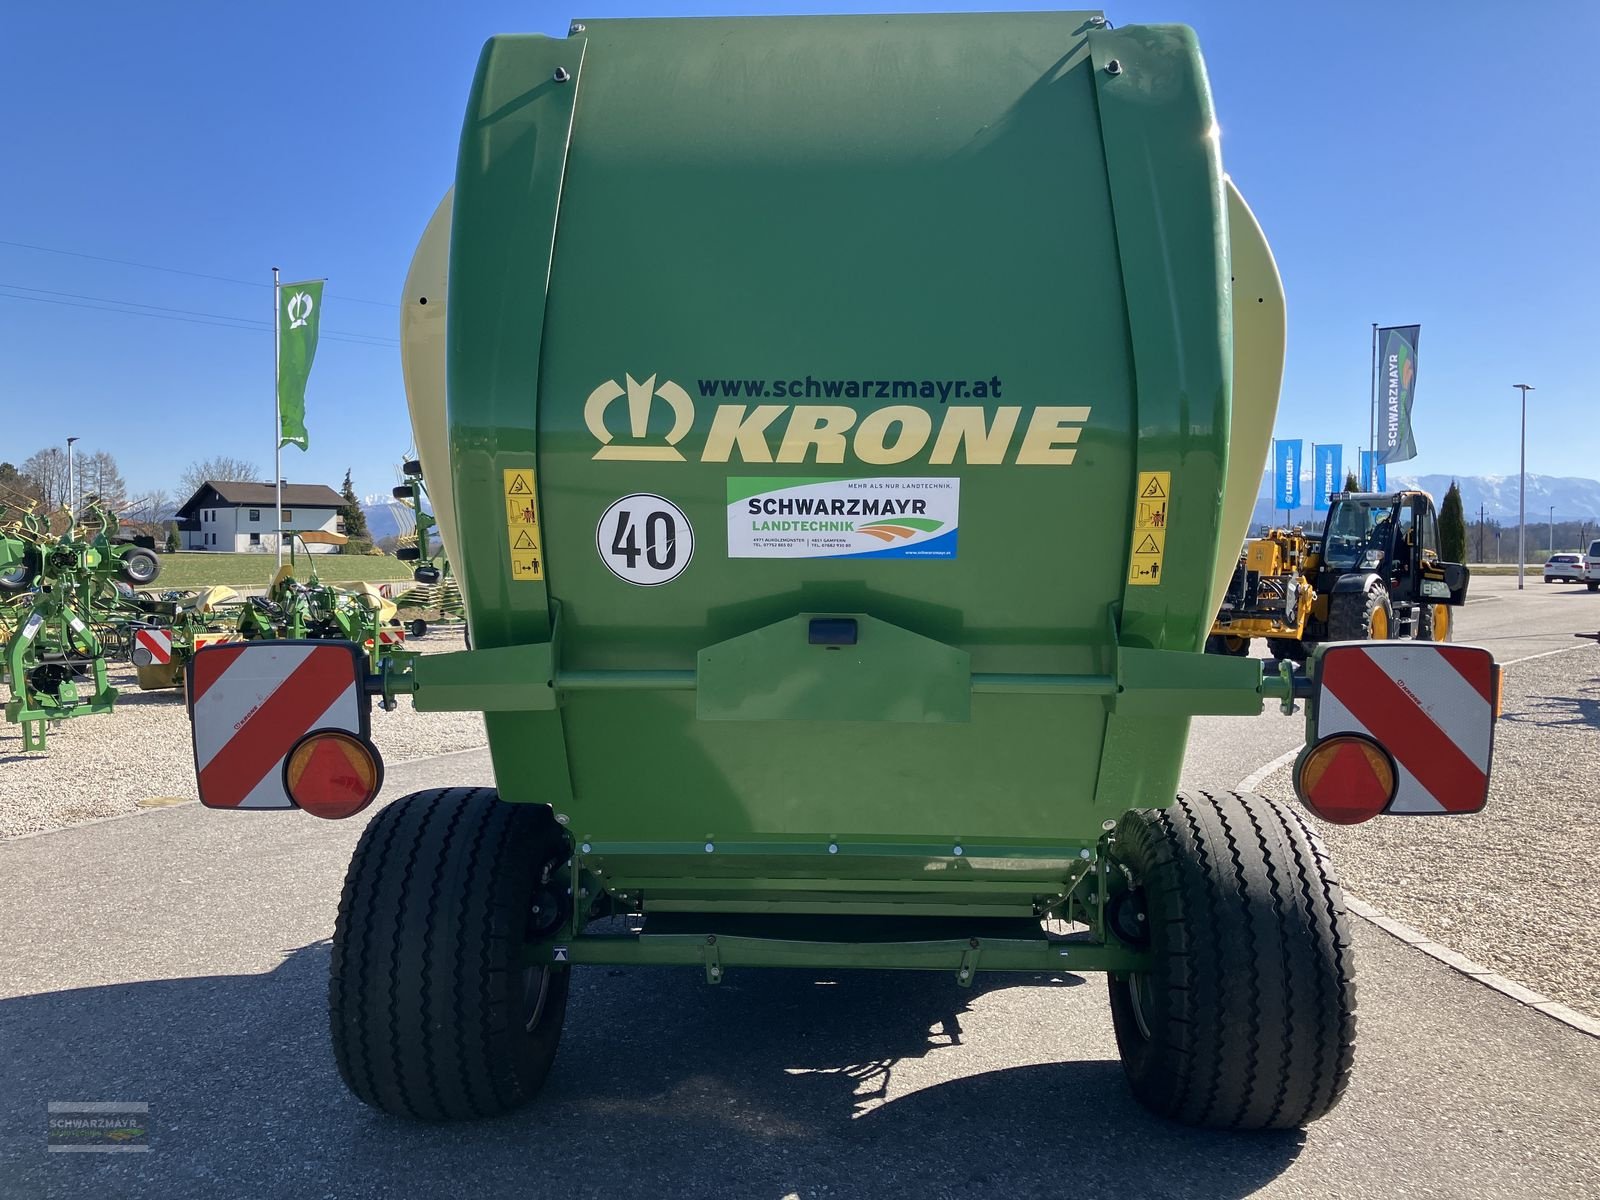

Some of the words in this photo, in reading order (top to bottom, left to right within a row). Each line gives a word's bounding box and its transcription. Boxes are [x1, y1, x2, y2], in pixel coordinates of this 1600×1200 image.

[697, 376, 1002, 404] www.schwarzmayr.at
[1388, 354, 1399, 447] SCHWARZMAYR
[700, 404, 1092, 465] KRONE
[1285, 460, 1293, 495] LEMKEN
[748, 498, 927, 516] SCHWARZMAYR
[611, 510, 676, 571] 40
[752, 520, 855, 532] LANDTECHNIK
